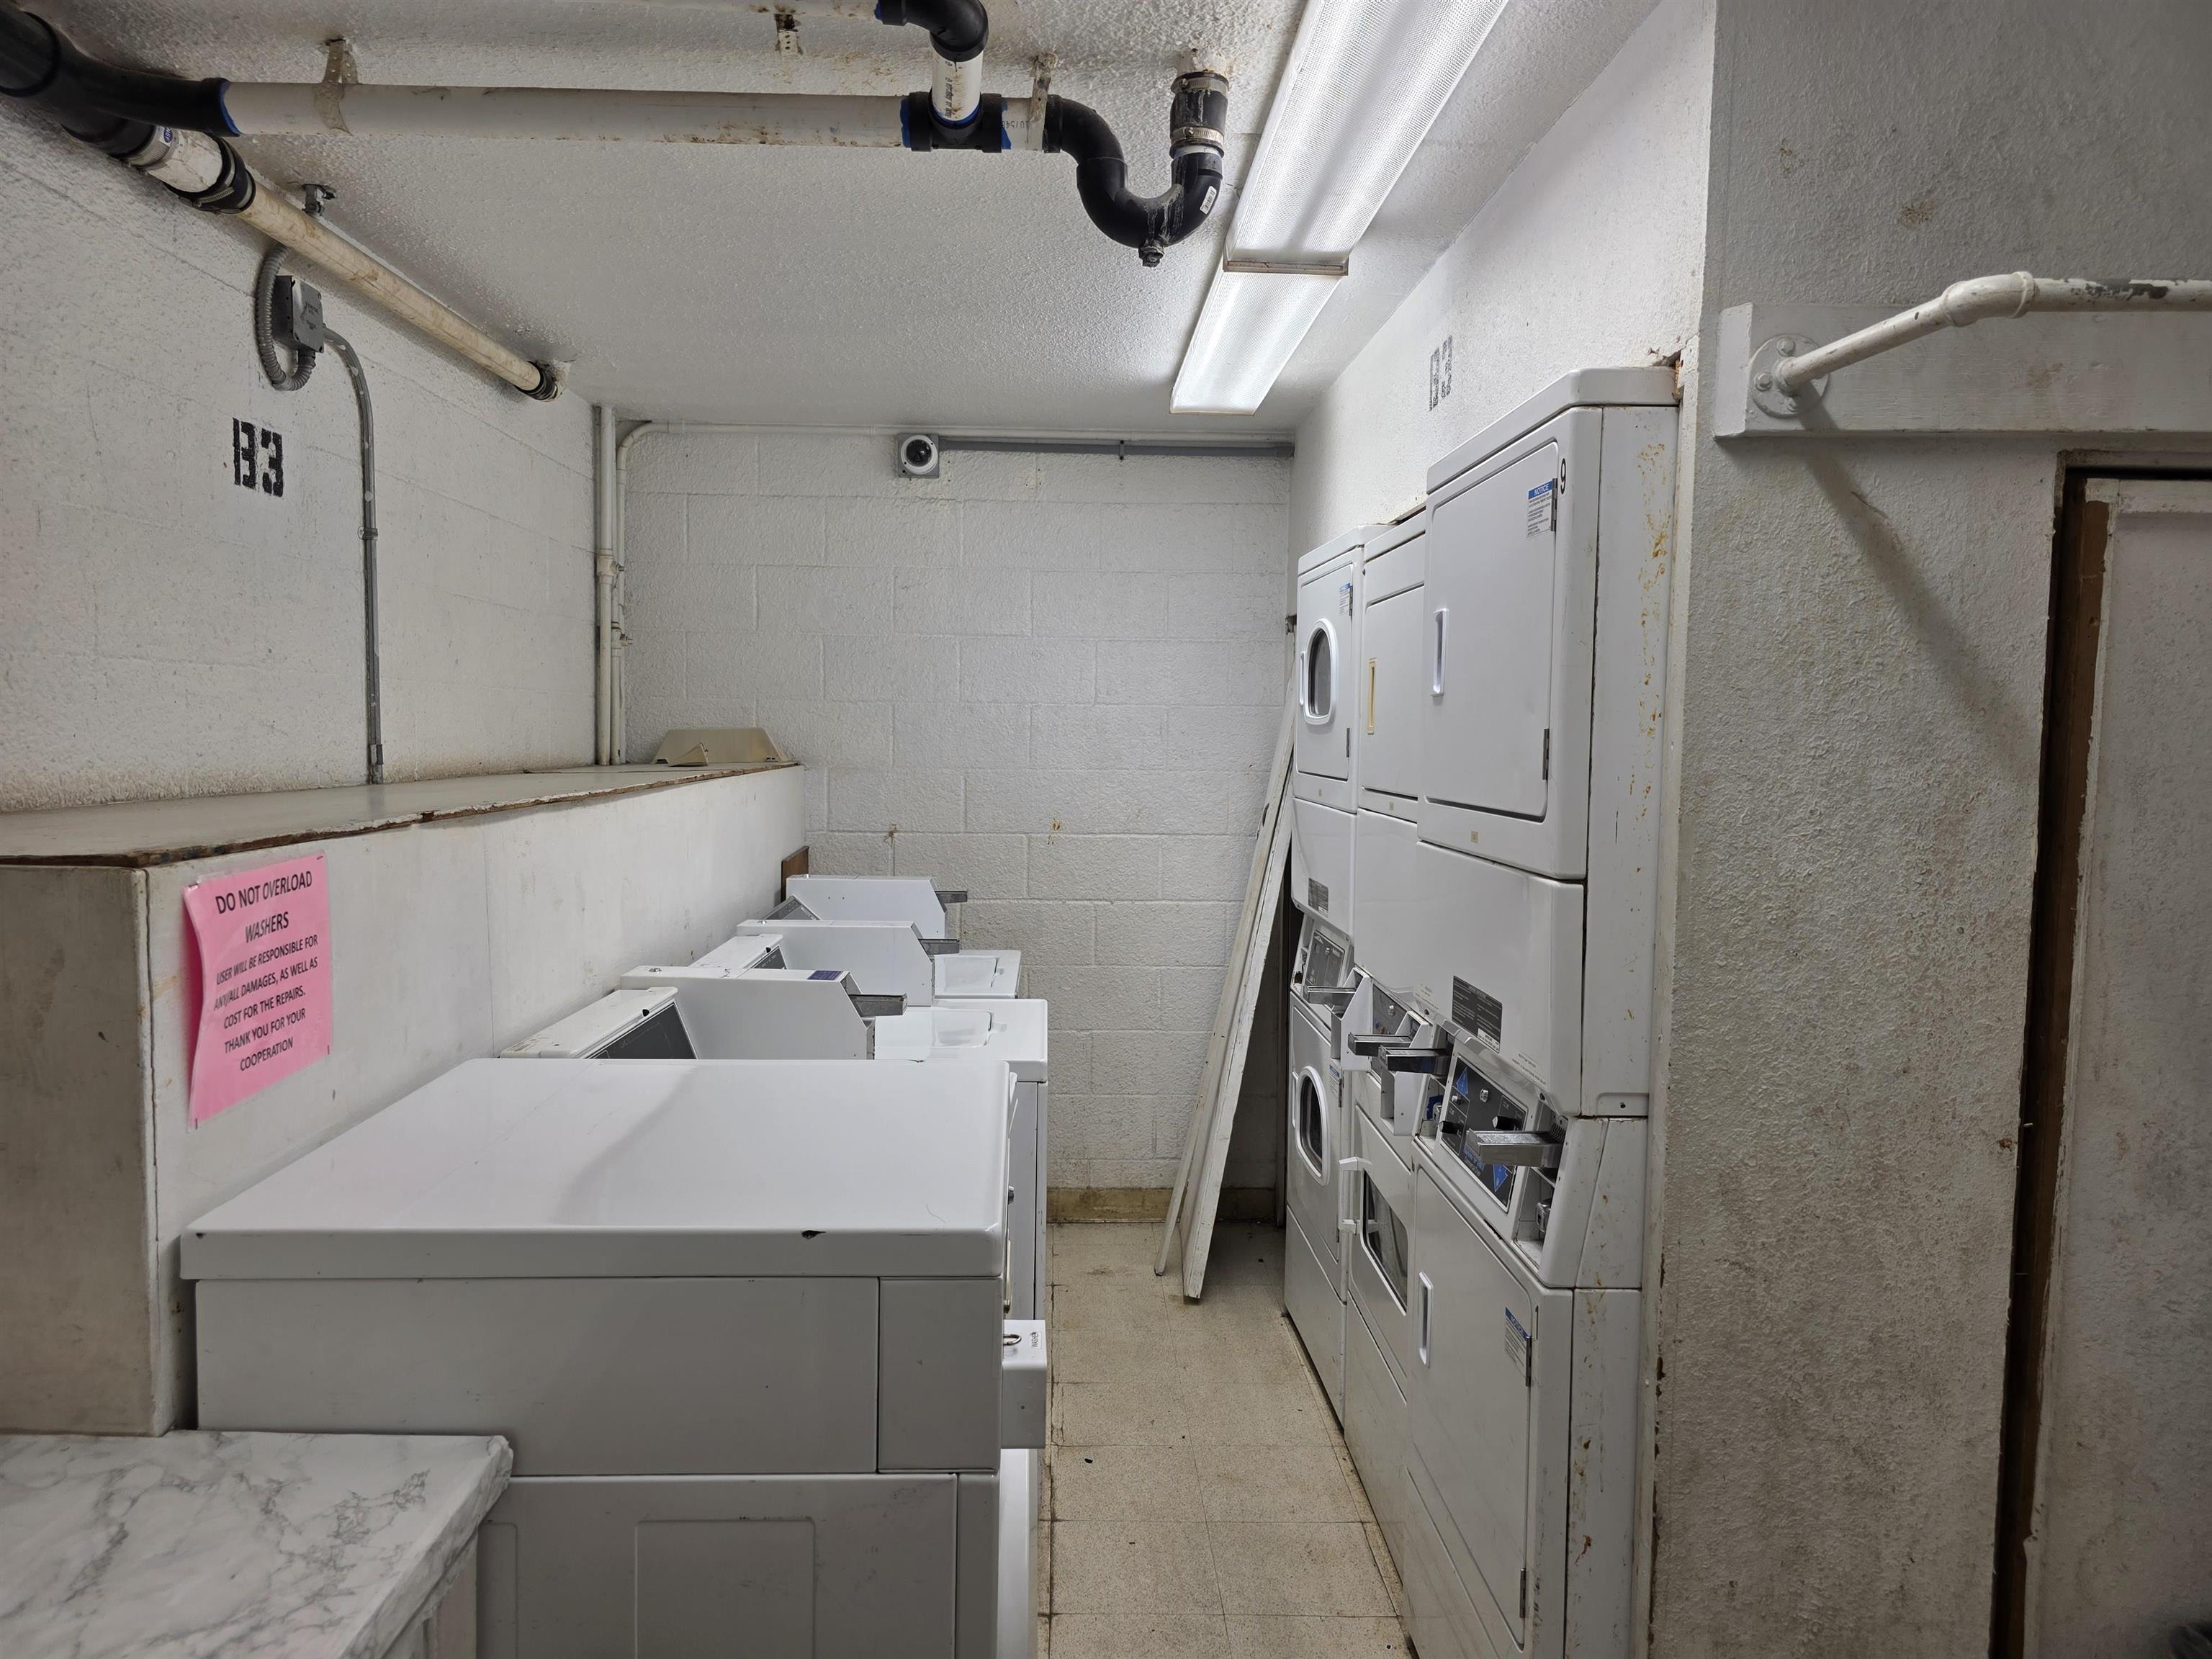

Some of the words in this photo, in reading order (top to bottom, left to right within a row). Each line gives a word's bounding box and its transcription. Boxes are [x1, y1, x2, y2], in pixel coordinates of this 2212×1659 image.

[1429, 334, 1453, 412] B3
[232, 417, 284, 497] B3
[1560, 458, 1566, 495] 9
[1534, 483, 1550, 496] NOTICE
[215, 892, 236, 914] DO
[238, 885, 261, 908] NOT
[263, 871, 313, 900] OVERLOAD
[246, 911, 289, 943] WASHERS
[216, 967, 233, 985] USER
[233, 960, 247, 976] WILL
[248, 956, 257, 969] BE
[258, 939, 303, 965] RESPONSIBLE
[305, 935, 318, 948] FOR
[214, 987, 240, 1011] ANY/ALL
[241, 972, 279, 997] DAMAGES,
[279, 967, 289, 981] AS
[290, 961, 308, 976] WELL
[310, 956, 318, 969] AS
[224, 1010, 242, 1029] COST
[243, 1004, 258, 1020] FOR
[260, 997, 274, 1012] THE
[276, 985, 306, 1007] REPAIRS.
[225, 1031, 251, 1053] THANK
[252, 1024, 269, 1040] YOU
[271, 1017, 285, 1033] FOR
[287, 1008, 306, 1025] YOUR
[240, 1037, 294, 1071] COOPERATION
